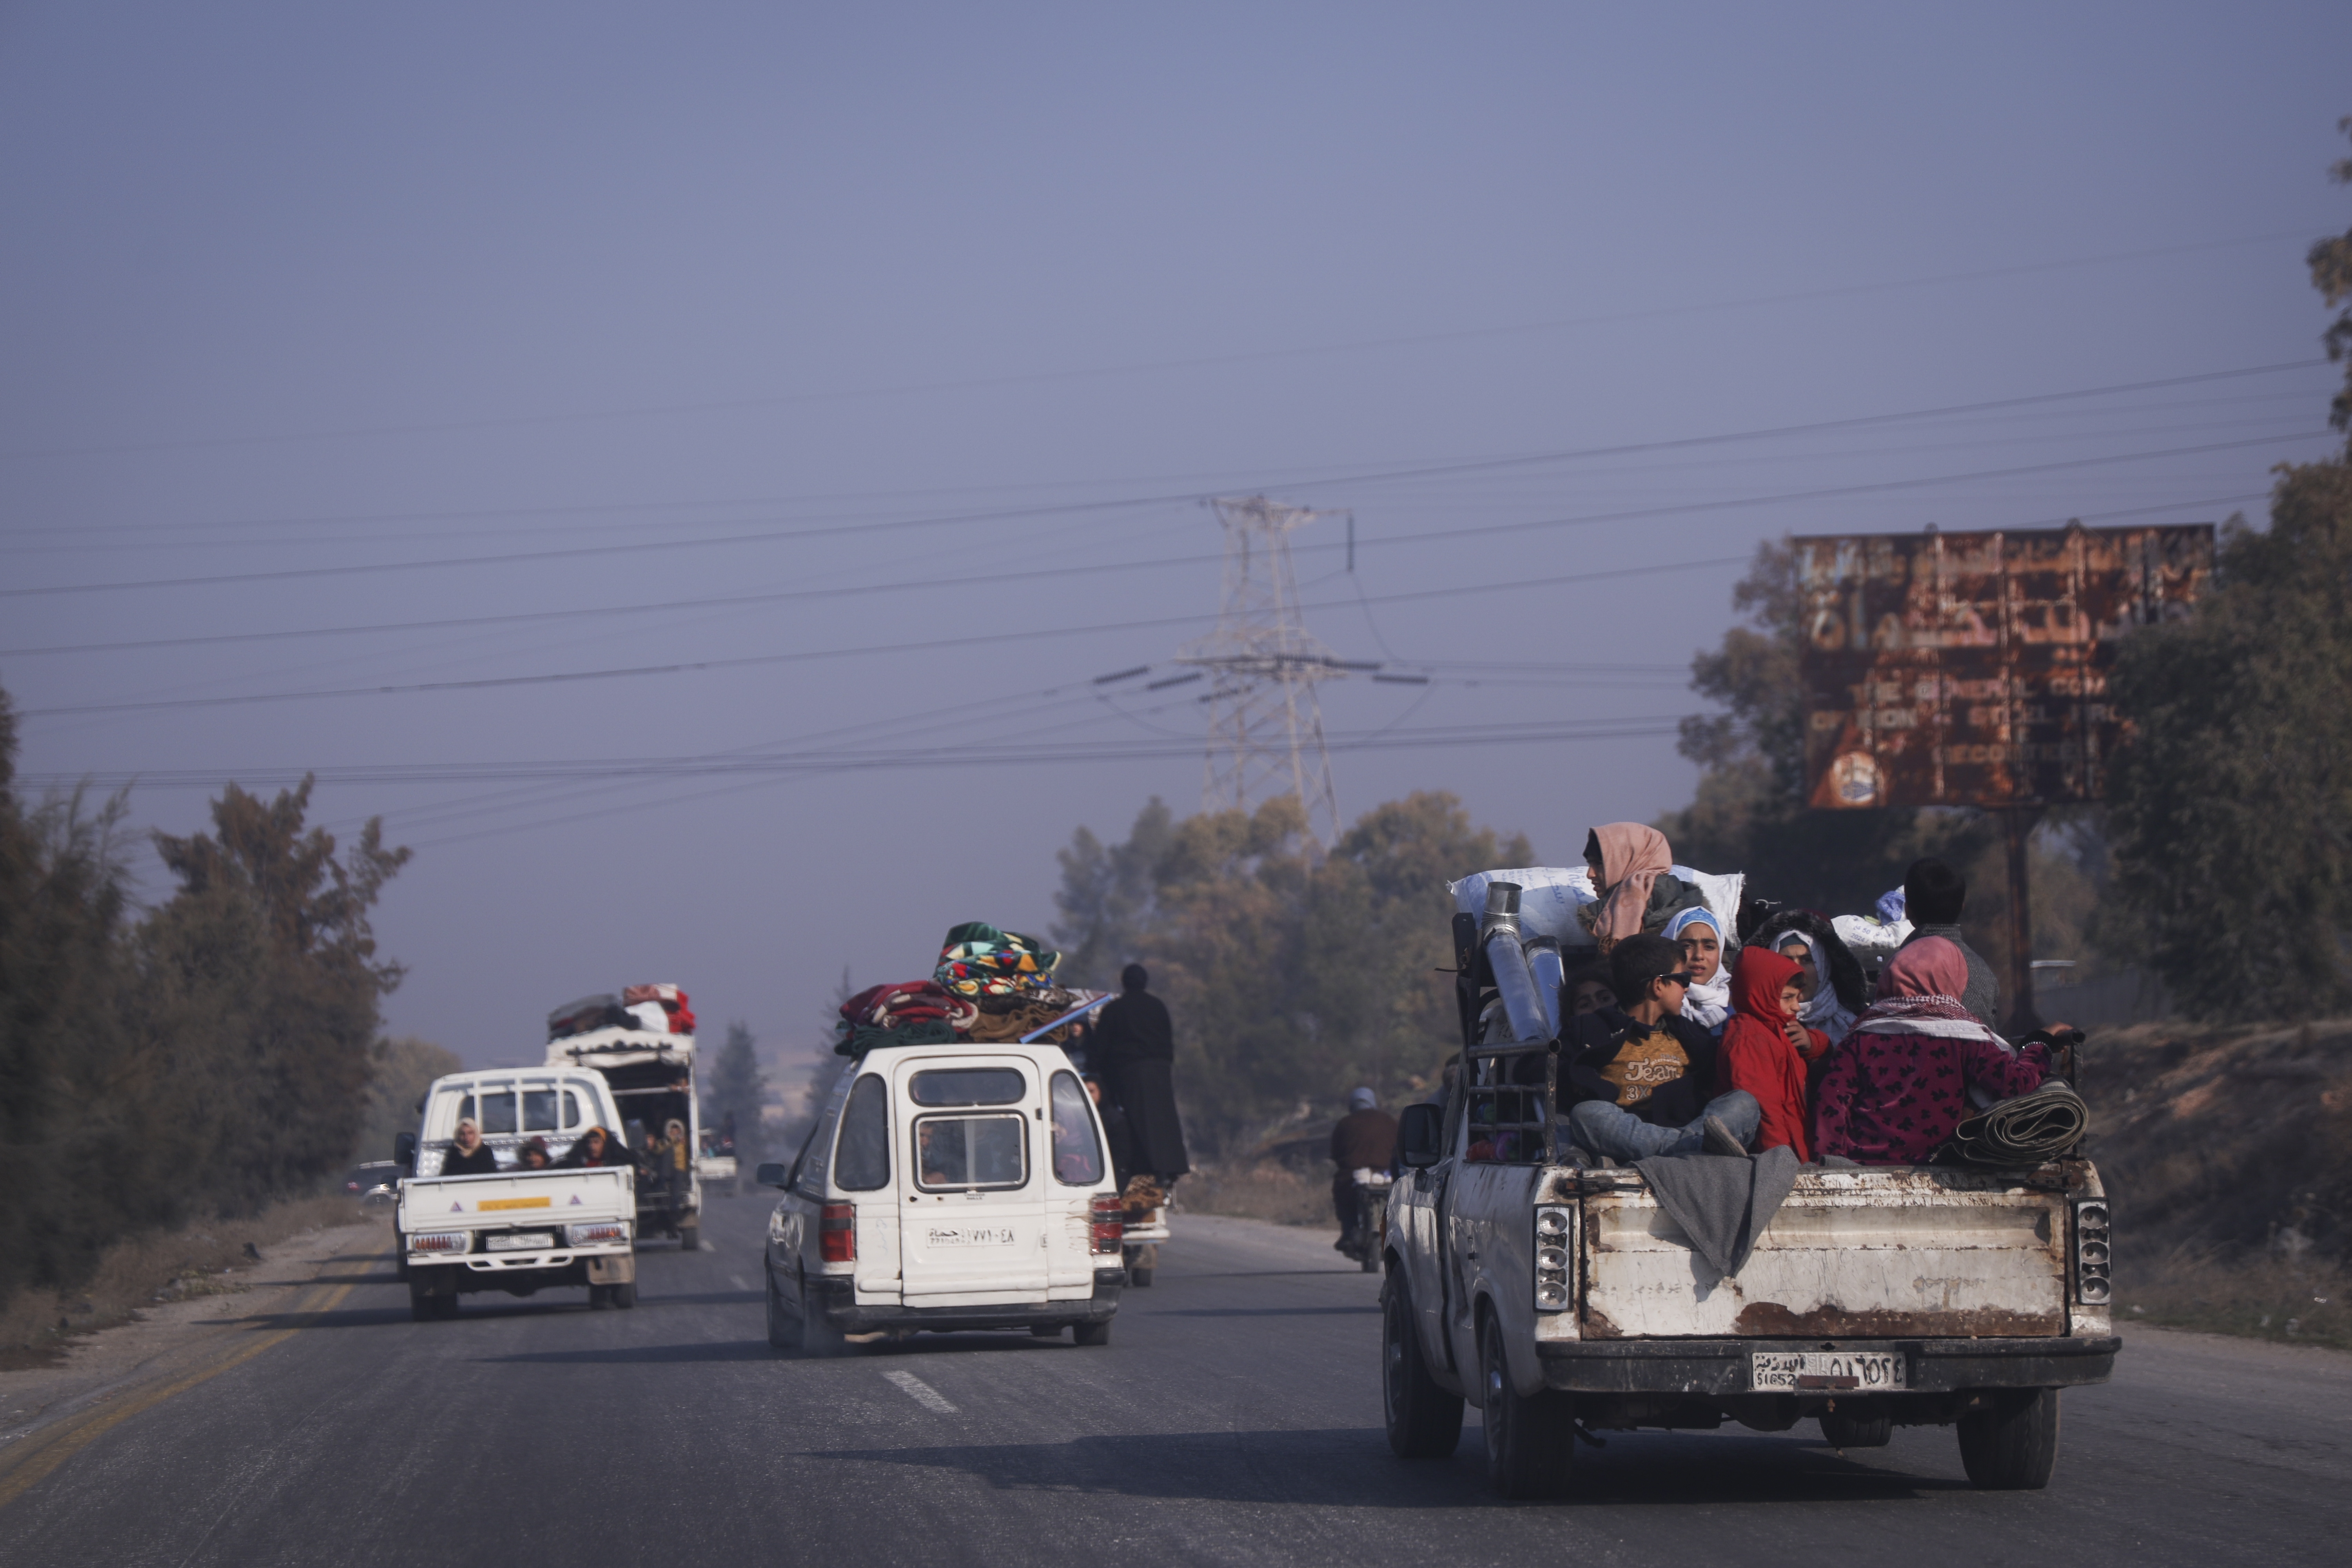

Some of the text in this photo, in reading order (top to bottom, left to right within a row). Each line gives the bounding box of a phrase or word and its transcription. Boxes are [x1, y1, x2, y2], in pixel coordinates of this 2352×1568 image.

[1625, 1057, 1681, 1082] Team
[929, 1229, 958, 1237] حماة
[1757, 1372, 1800, 1386] 51652
